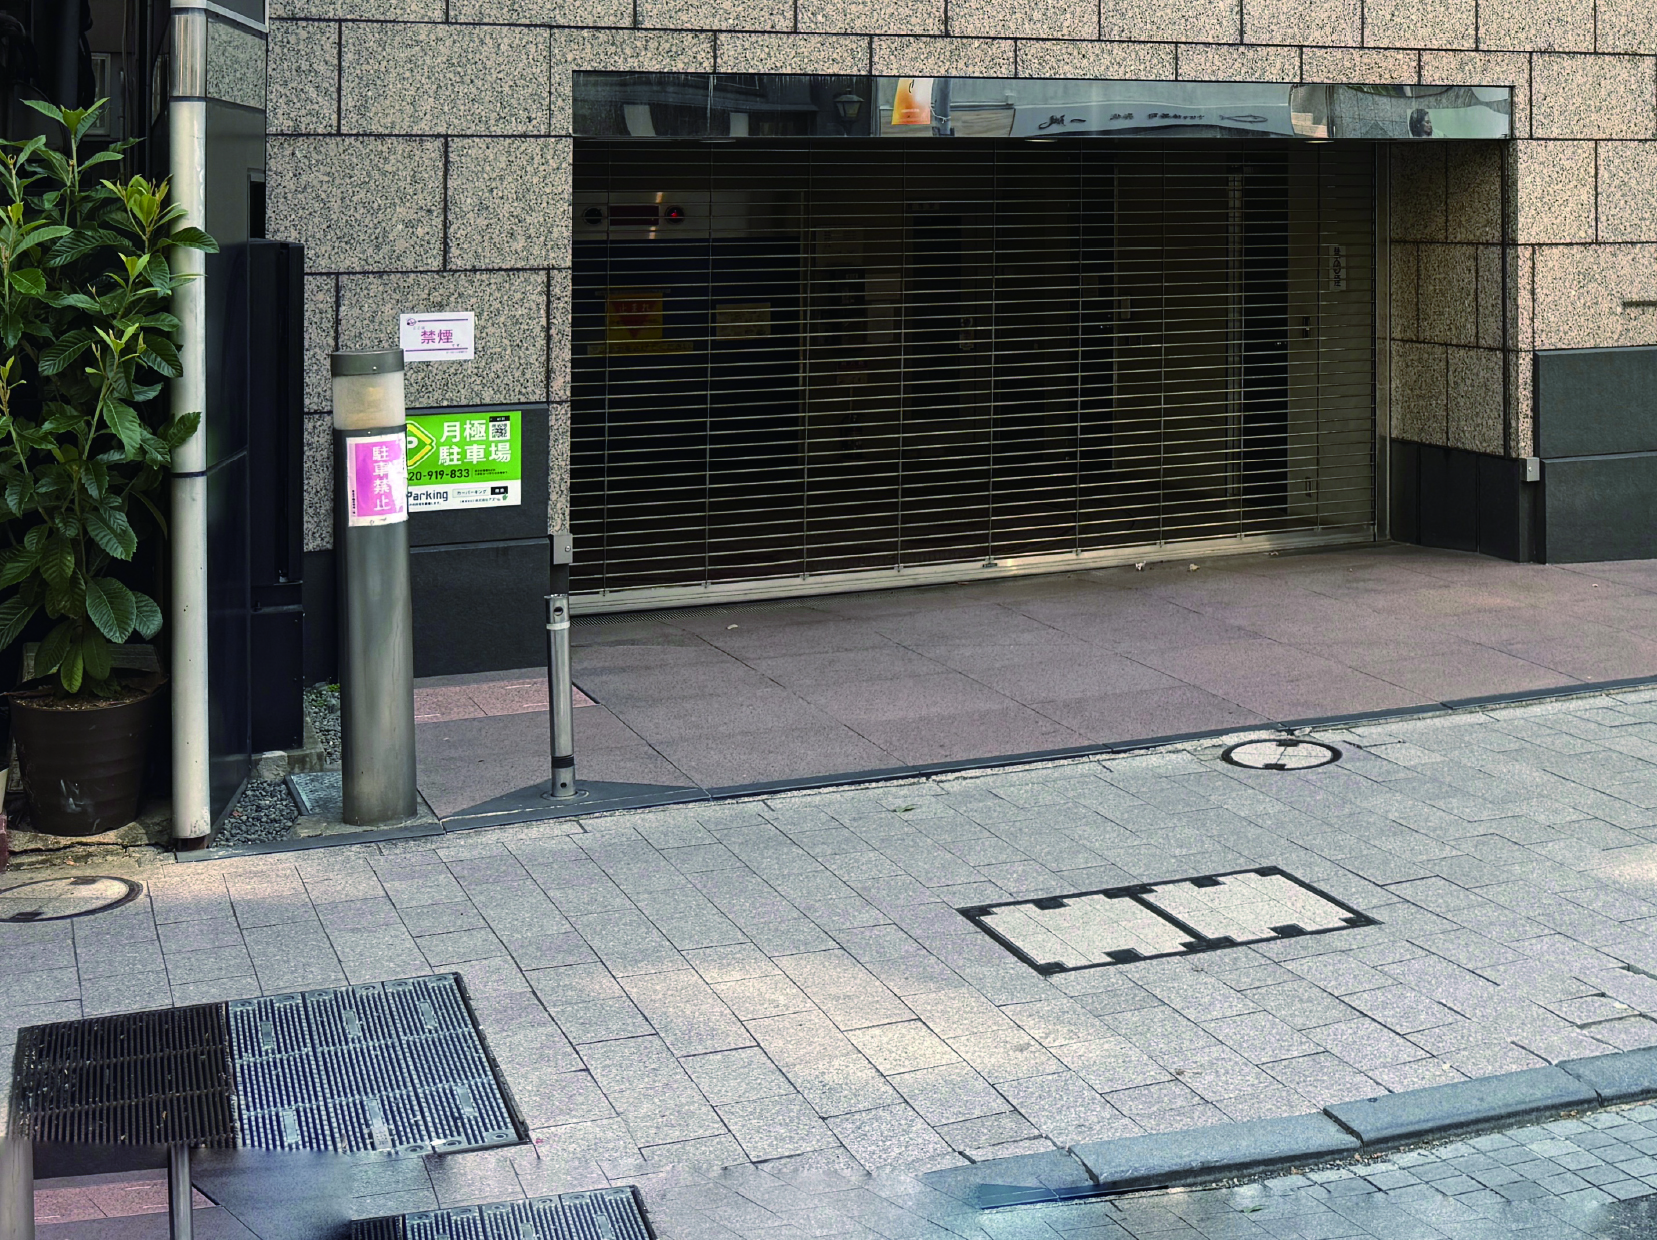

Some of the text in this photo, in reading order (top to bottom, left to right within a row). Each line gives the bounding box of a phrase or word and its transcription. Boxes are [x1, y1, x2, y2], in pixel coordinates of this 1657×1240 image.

[420, 328, 454, 345] 禁煙
[440, 420, 487, 443] 月極
[438, 441, 511, 466] 駐車場
[372, 445, 392, 512] 駐車禁止
[406, 490, 449, 502] Parking
